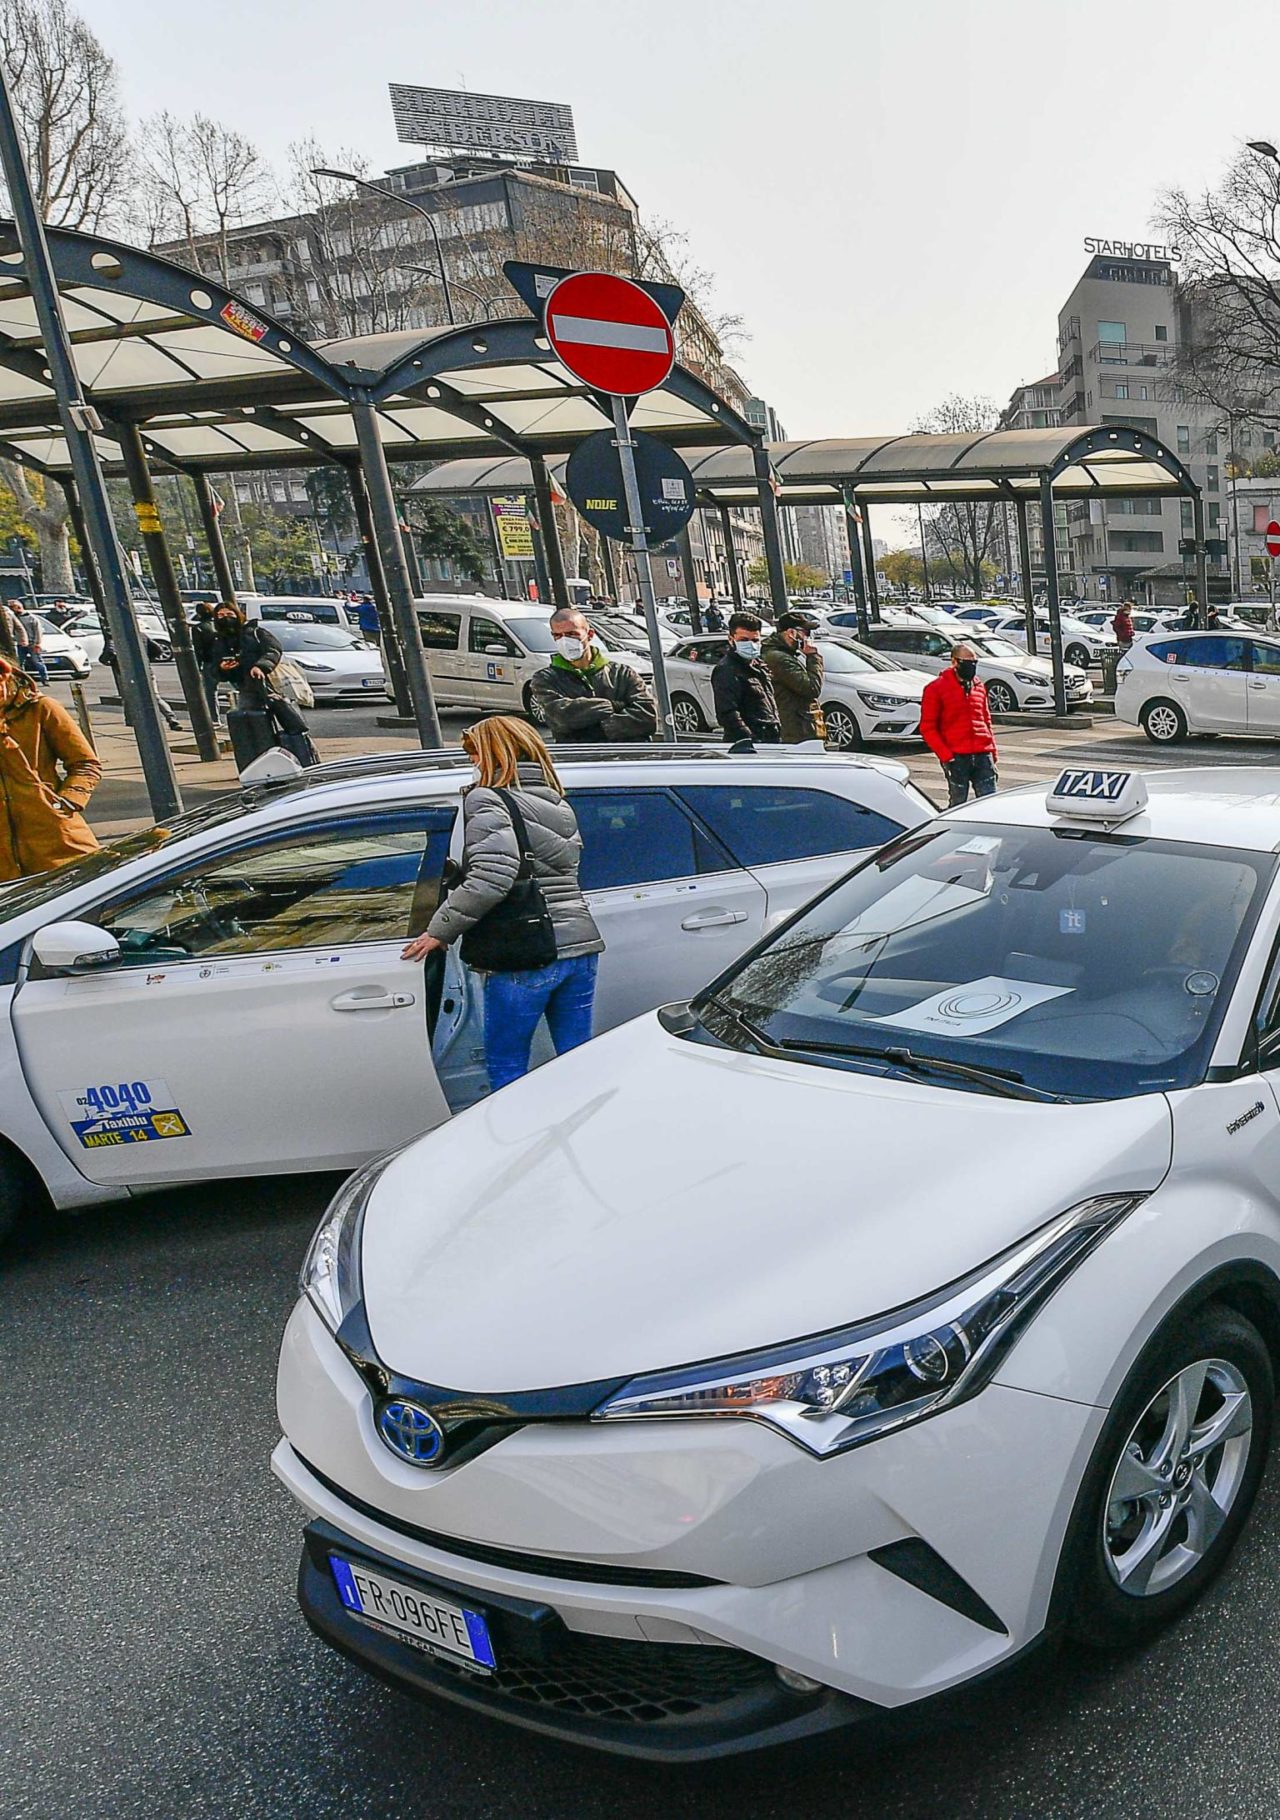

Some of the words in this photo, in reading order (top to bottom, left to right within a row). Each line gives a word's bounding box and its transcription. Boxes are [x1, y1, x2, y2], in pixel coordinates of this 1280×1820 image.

[408, 119, 568, 153] ANDERSON
[1084, 237, 1182, 262] STARHOTELS
[1062, 771, 1127, 797] TAXI
[87, 1081, 151, 1114] 4040
[103, 1116, 148, 1130] Taxiblu
[84, 1132, 124, 1148] MARTE
[130, 1130, 148, 1142] 14
